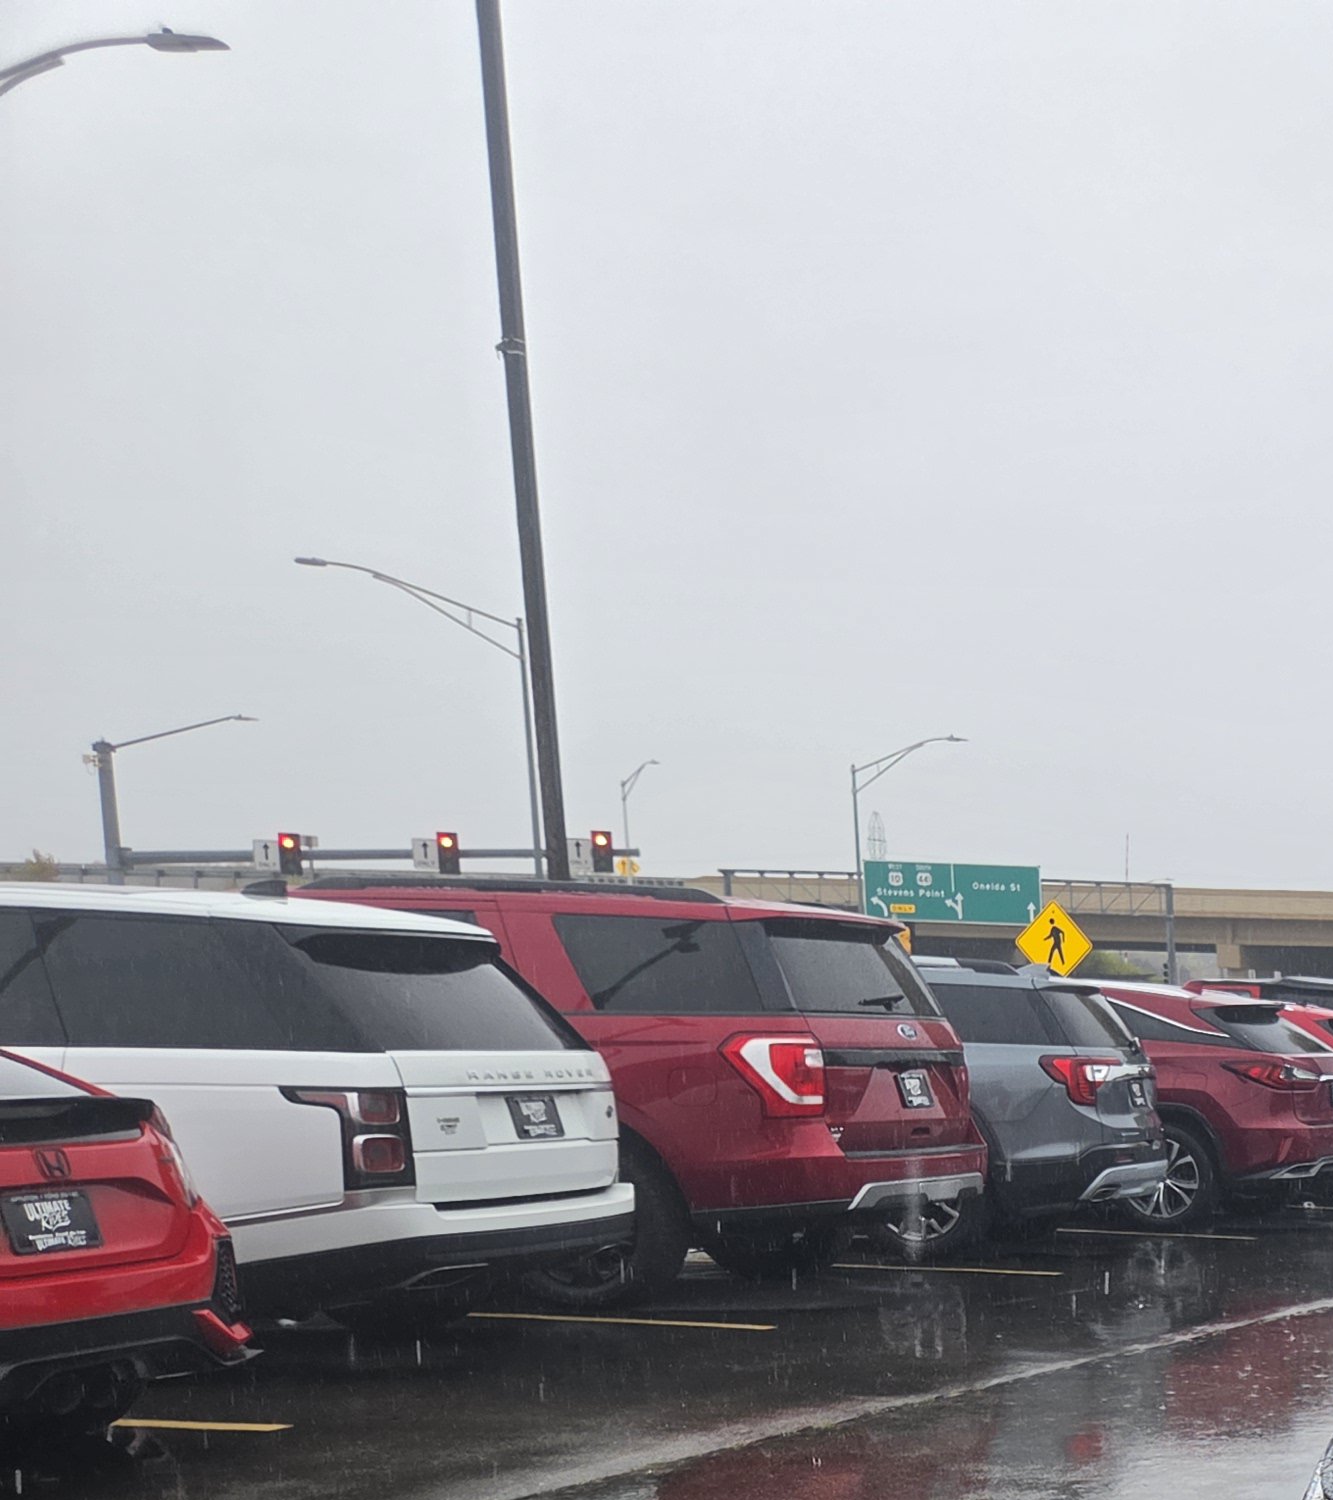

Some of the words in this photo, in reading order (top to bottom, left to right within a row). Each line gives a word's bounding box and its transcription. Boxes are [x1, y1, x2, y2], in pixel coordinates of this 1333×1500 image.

[972, 881, 1005, 892] Oneida
[1010, 883, 1021, 892] St
[876, 887, 914, 897] Stevens
[918, 888, 945, 898] Point
[466, 1069, 534, 1080] RANGE
[543, 1068, 594, 1079] ROVER
[23, 1200, 71, 1221] ULTIMATE
